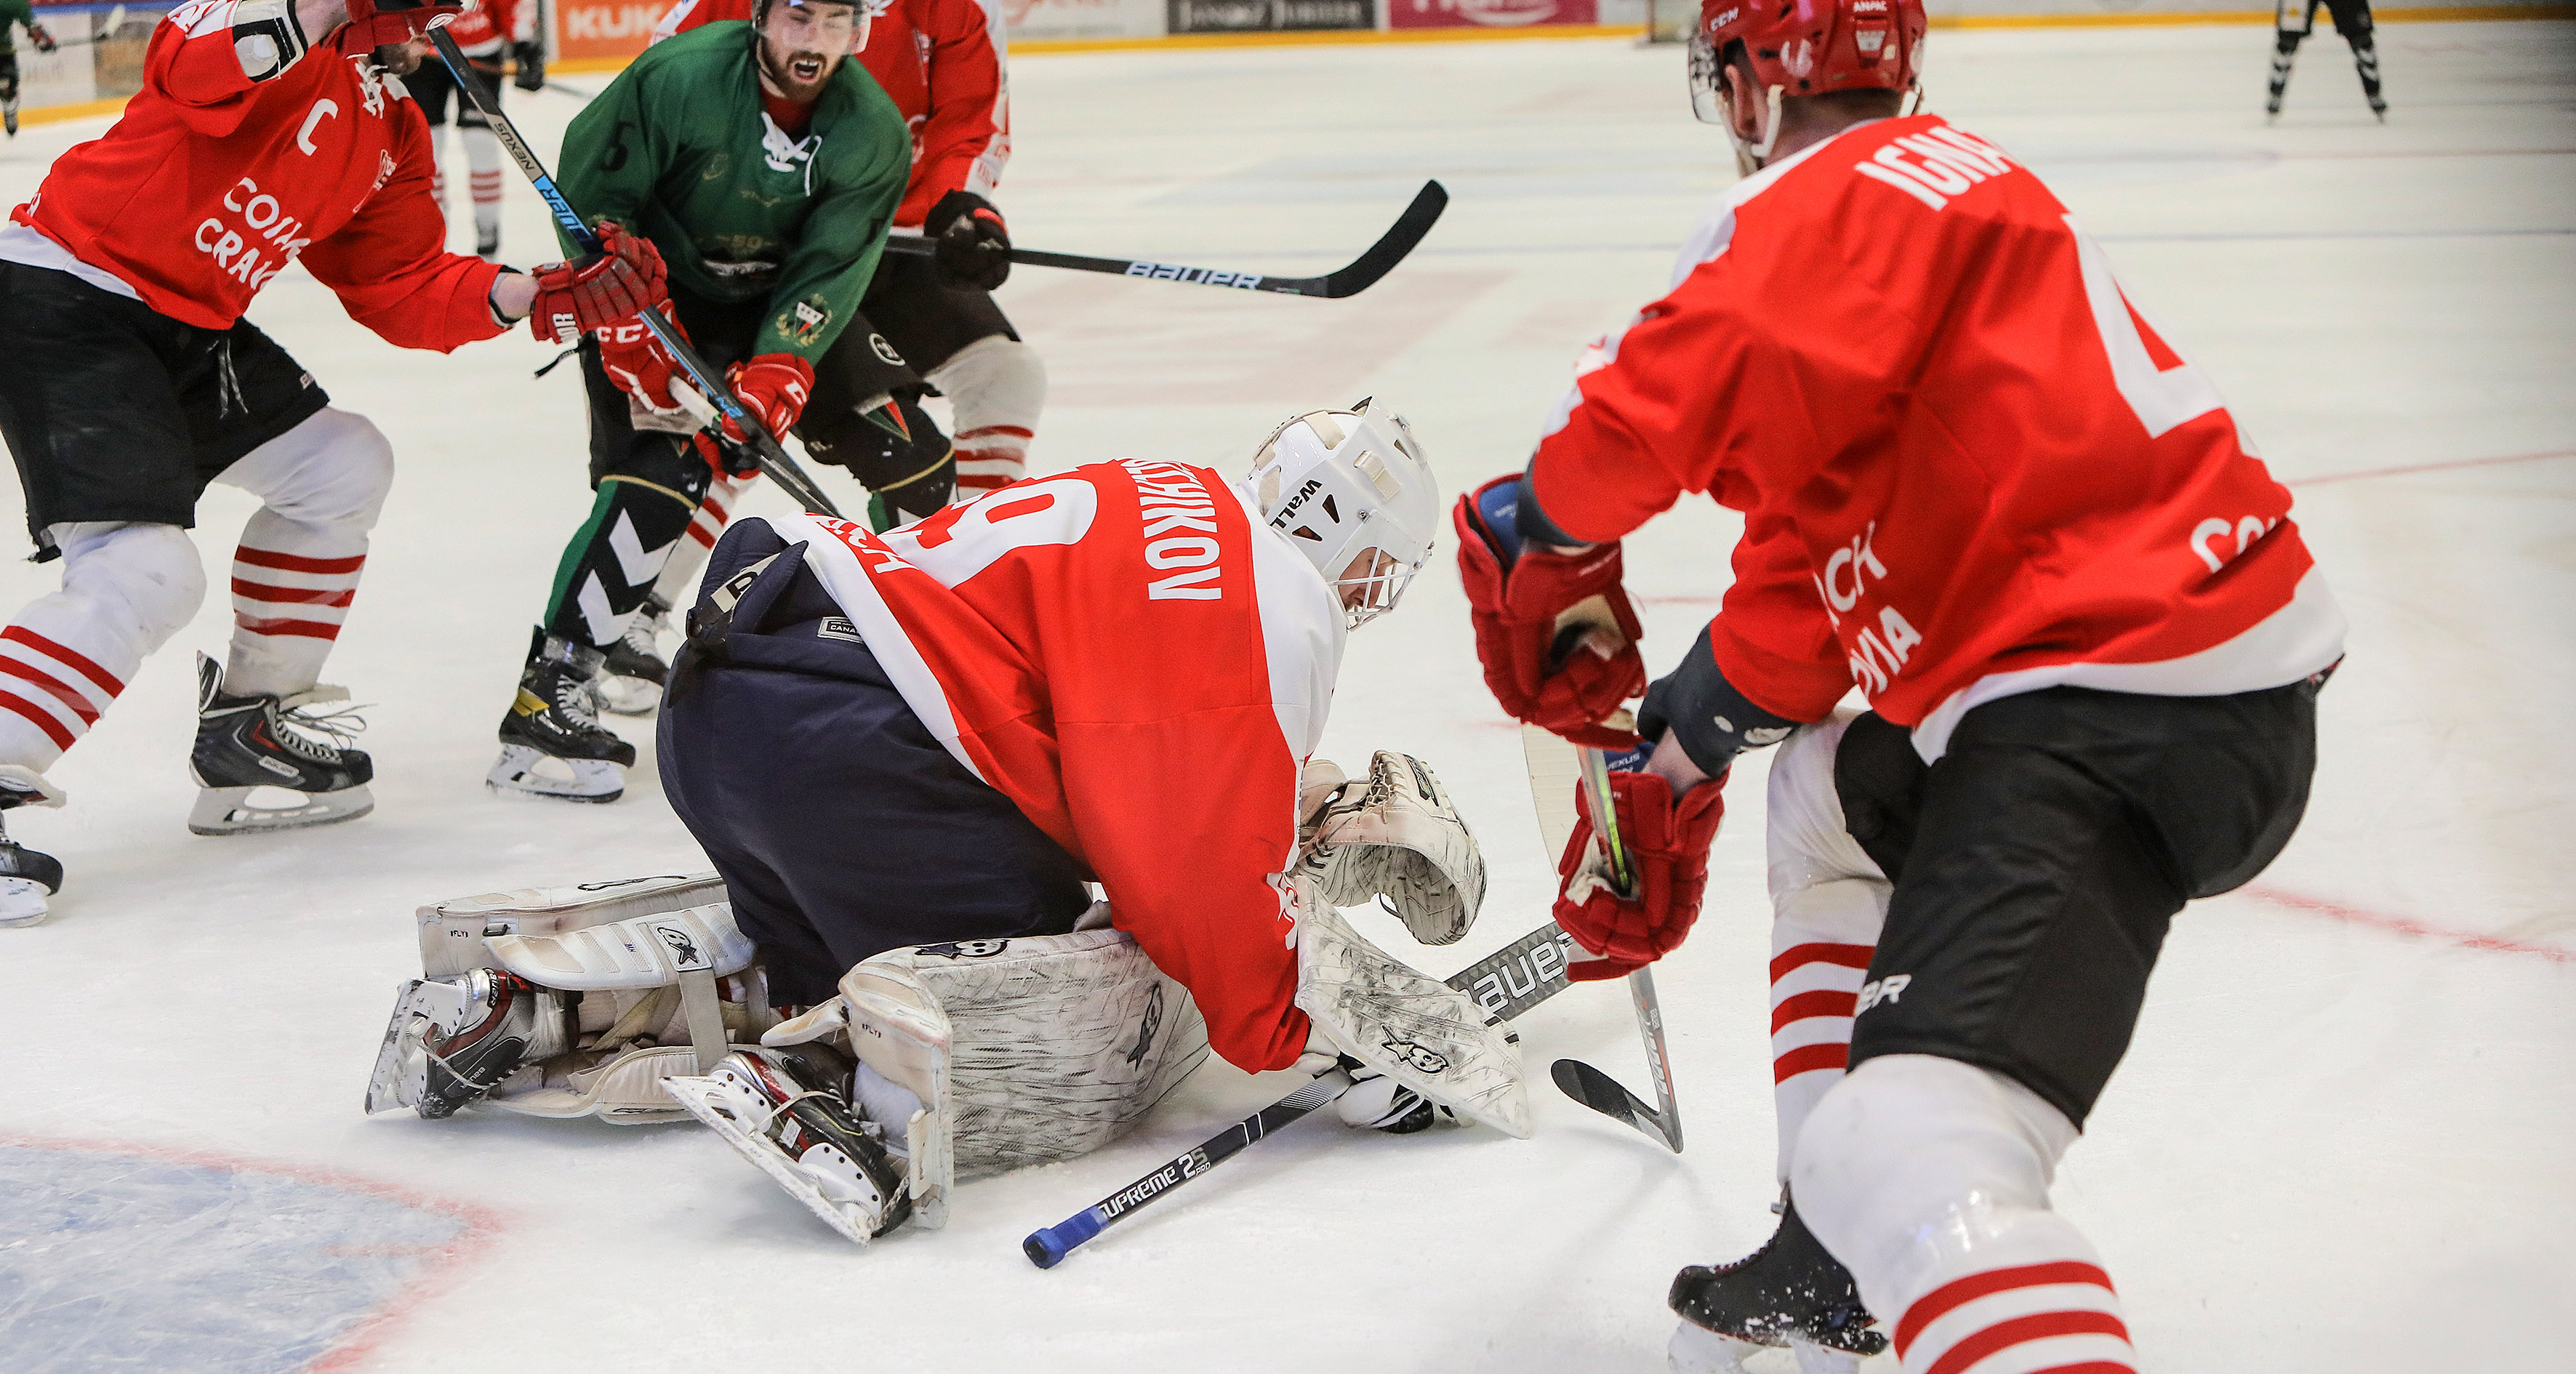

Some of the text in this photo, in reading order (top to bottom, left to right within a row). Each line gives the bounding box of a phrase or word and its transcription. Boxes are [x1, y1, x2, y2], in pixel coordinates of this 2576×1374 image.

[297, 98, 339, 156] C
[494, 122, 534, 170] NEXUS
[870, 477, 1099, 591] 9
[1813, 521, 1888, 631] CH
